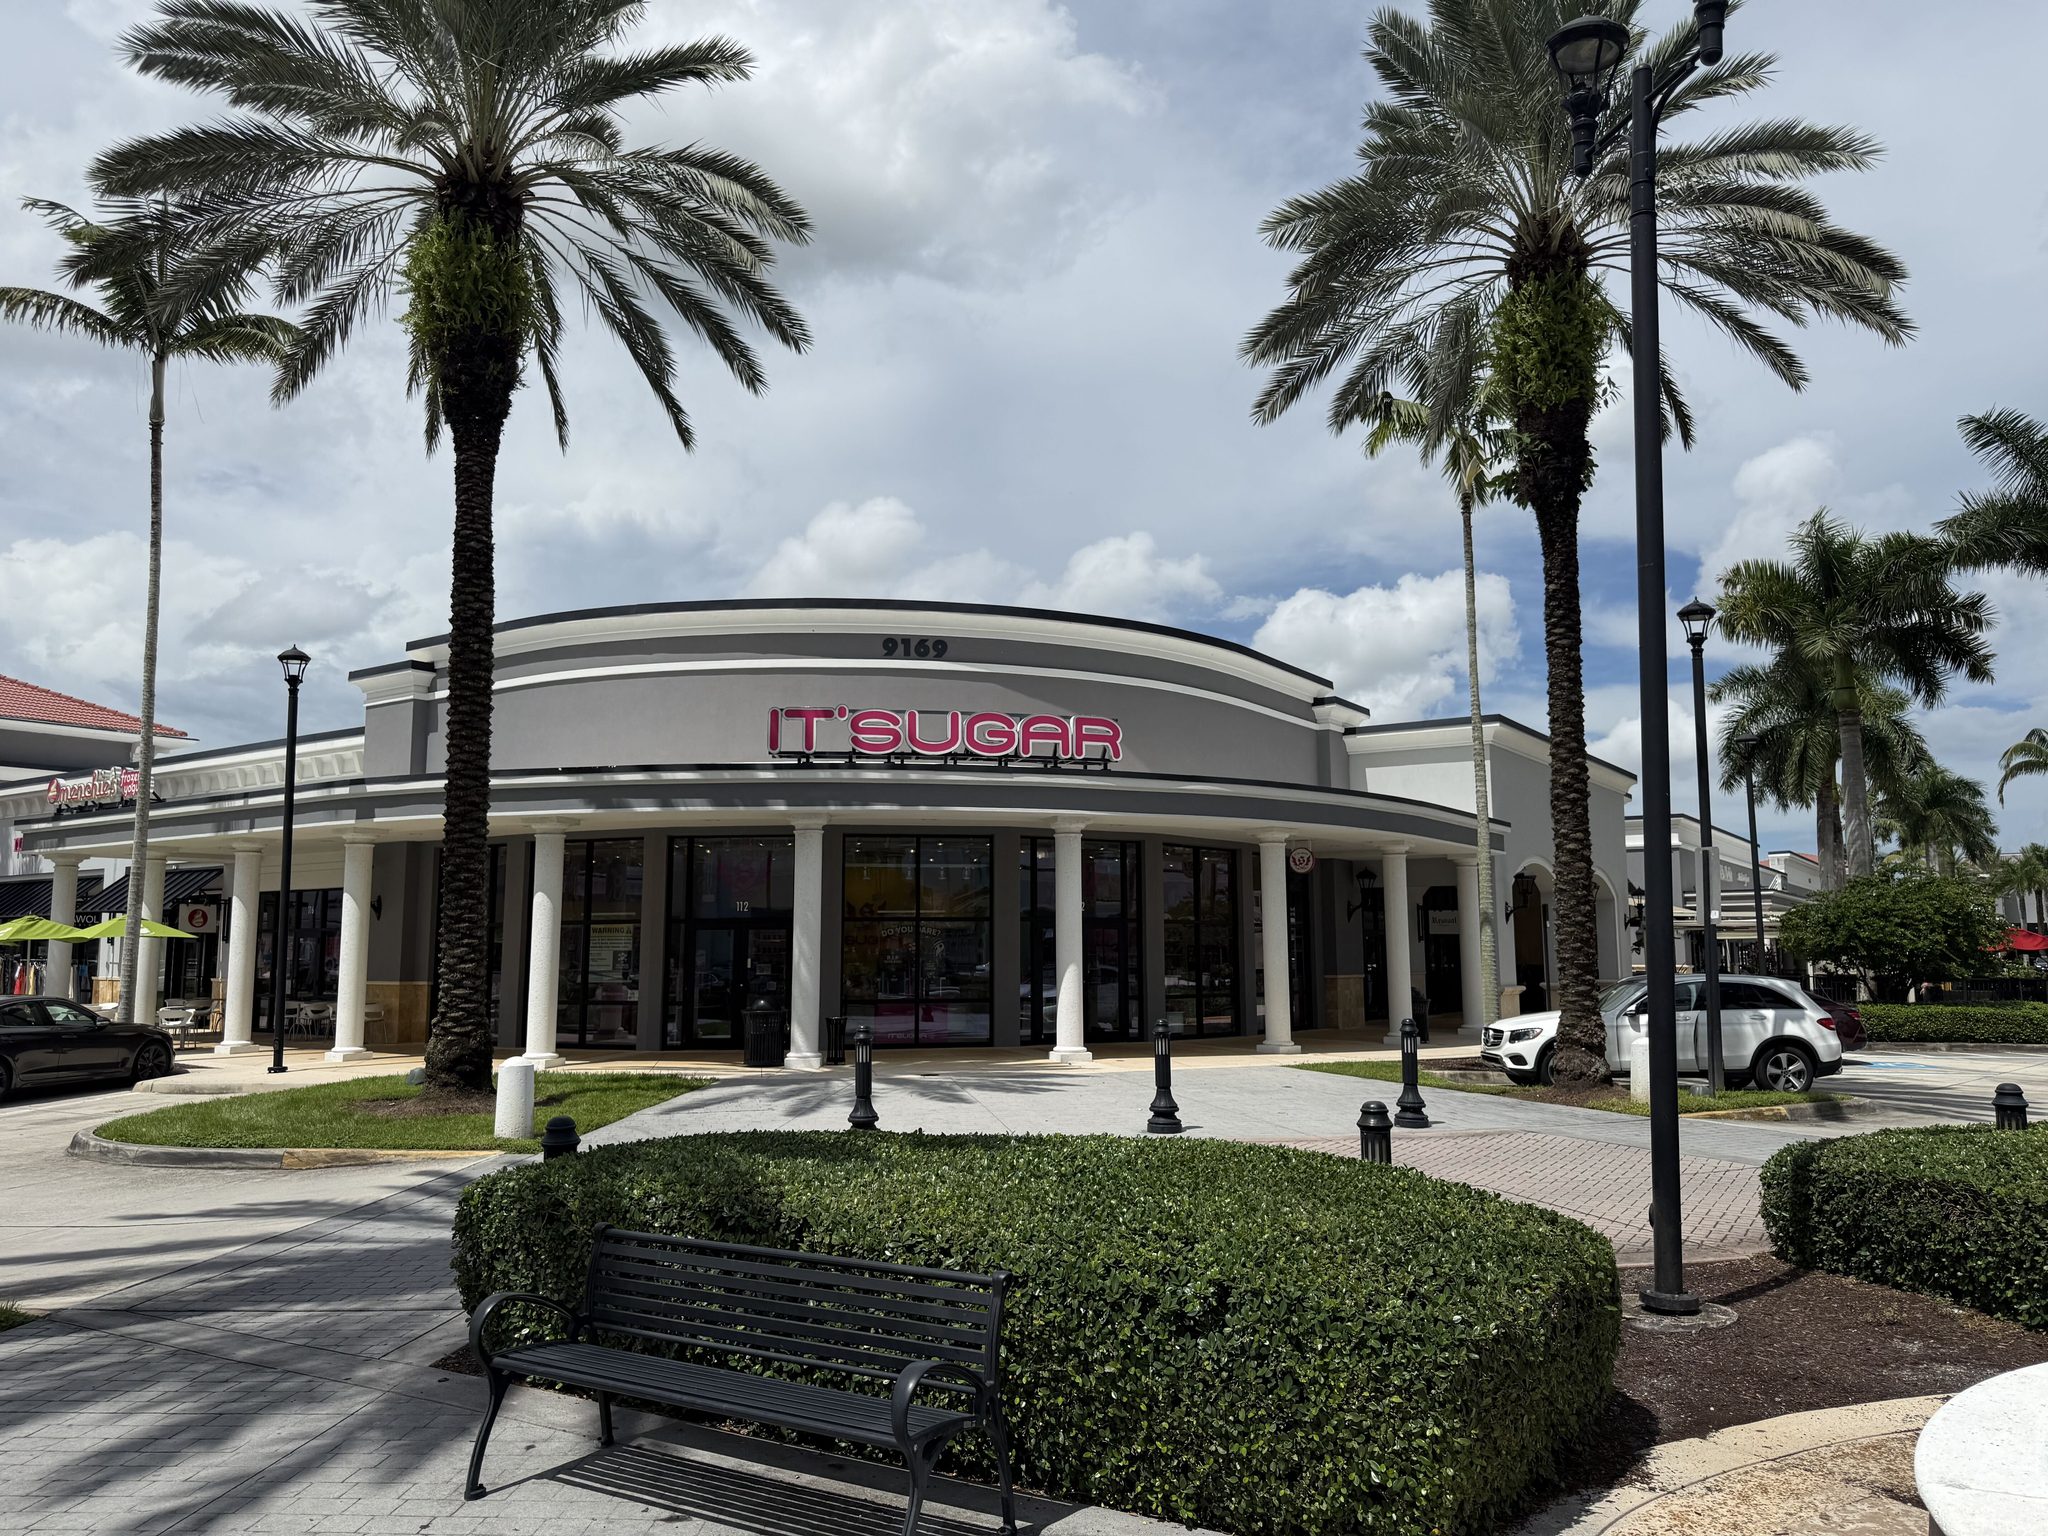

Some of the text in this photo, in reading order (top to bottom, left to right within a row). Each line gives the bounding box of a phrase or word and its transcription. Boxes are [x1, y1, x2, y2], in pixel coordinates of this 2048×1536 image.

[882, 637, 948, 658] 9169
[767, 704, 1123, 762] IT'SUGAR
[735, 901, 749, 911] 112
[895, 925, 913, 934] YOU
